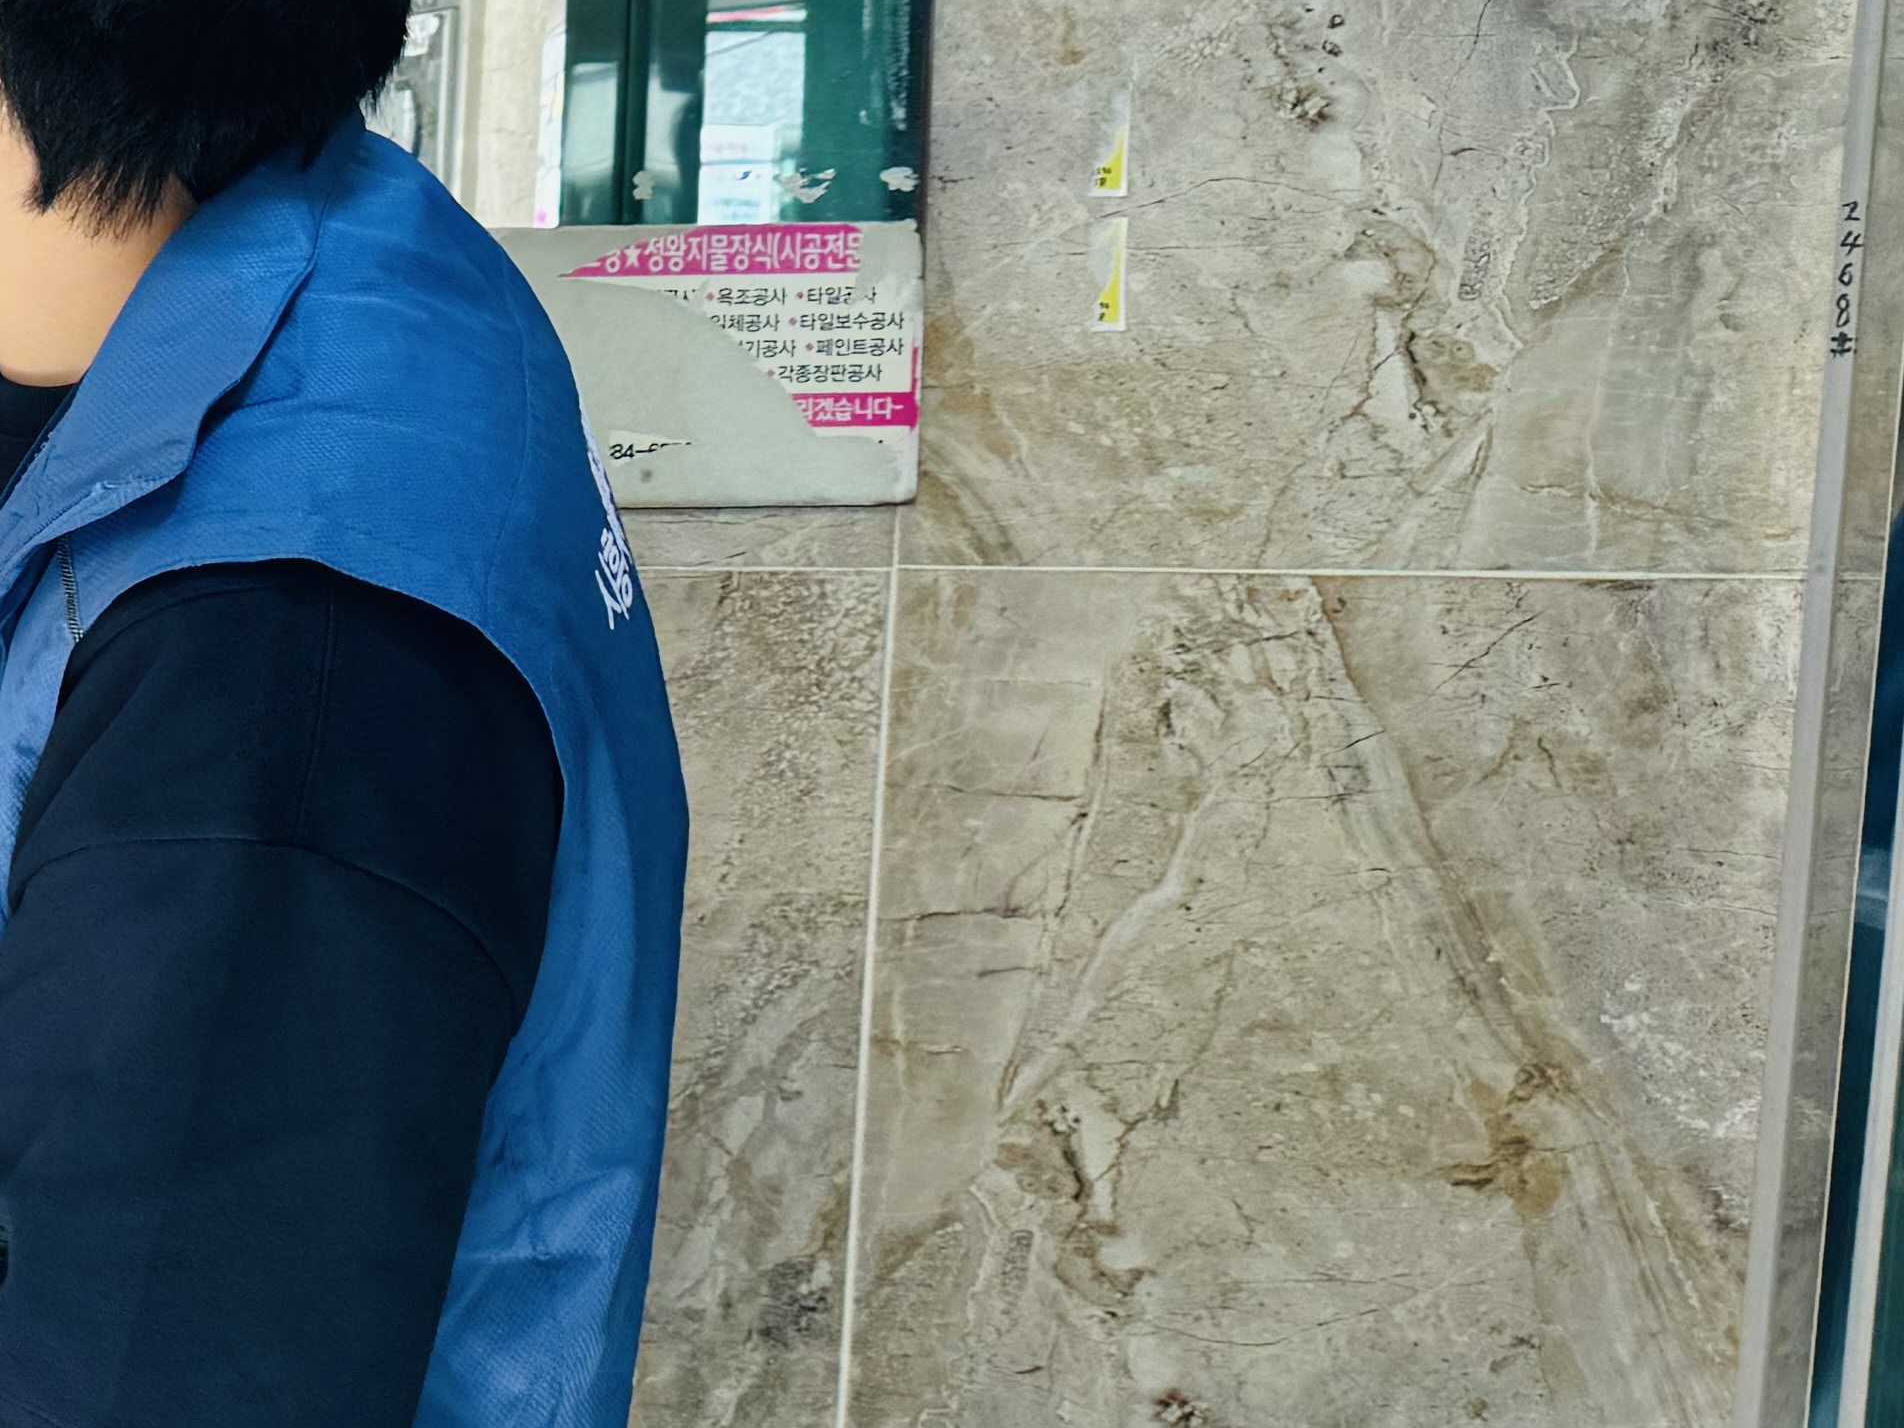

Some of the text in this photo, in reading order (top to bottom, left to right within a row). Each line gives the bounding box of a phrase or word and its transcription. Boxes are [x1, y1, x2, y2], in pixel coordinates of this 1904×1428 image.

[800, 311, 905, 332] 타일보수공사
[816, 337, 905, 357] 페인트공사
[778, 363, 883, 383] 각종장판공사
